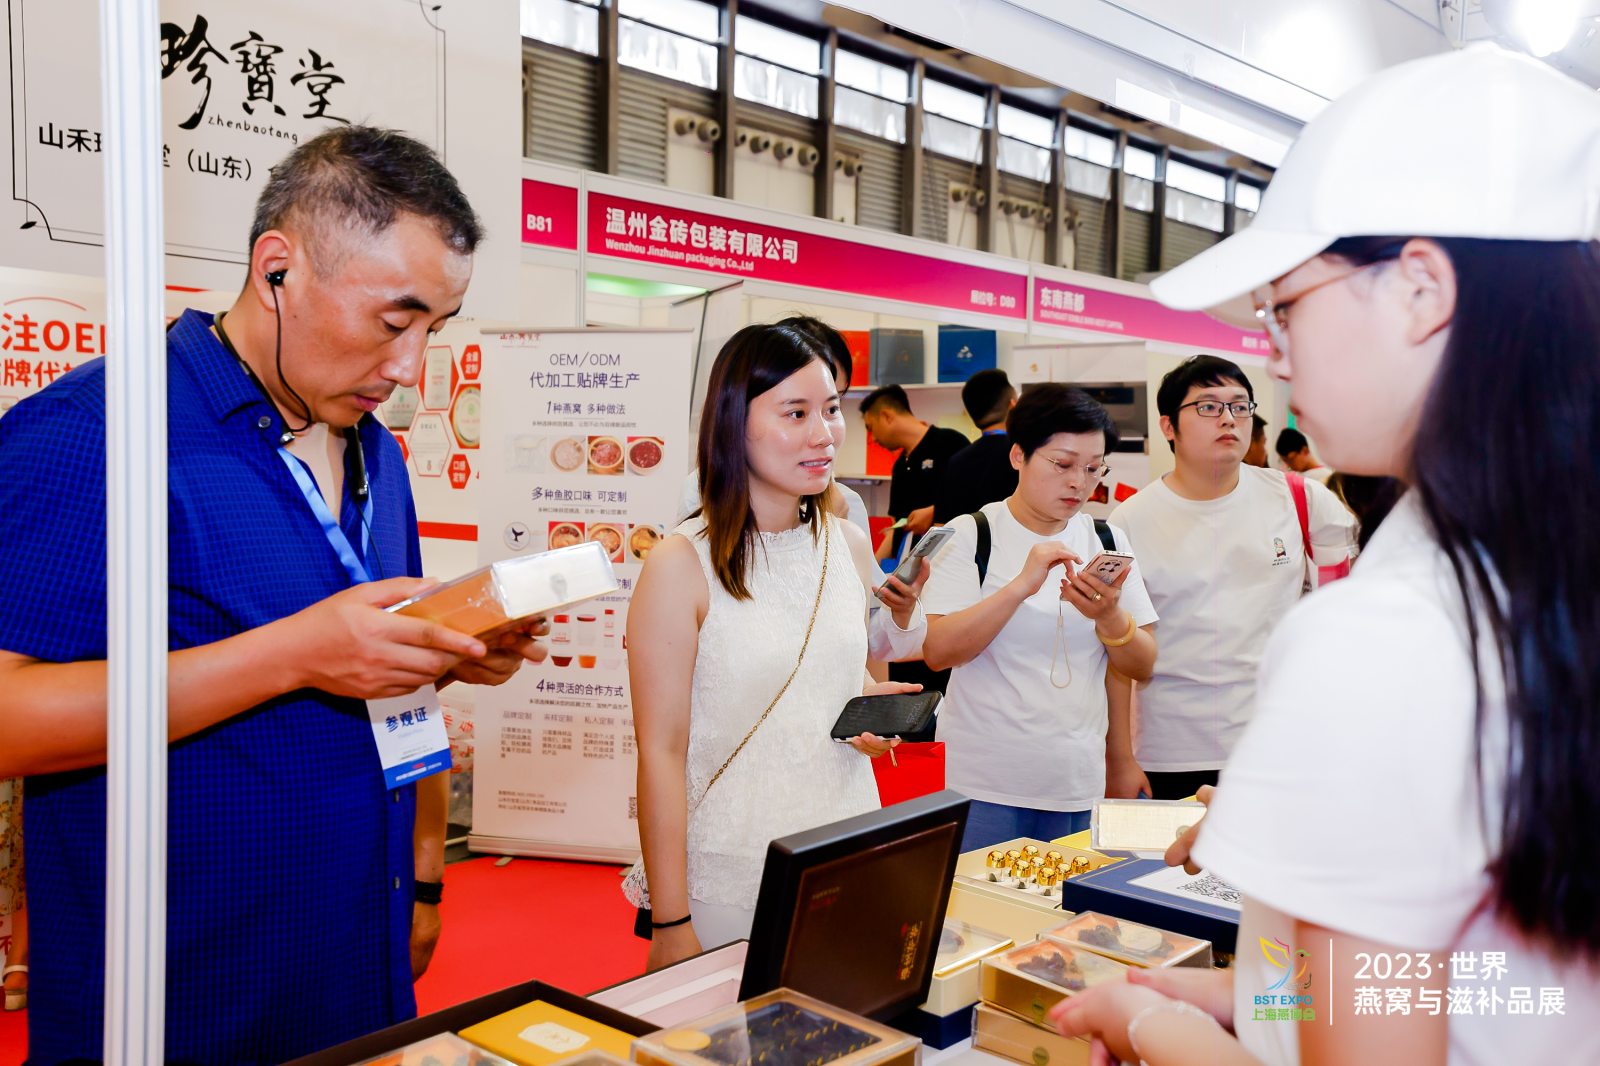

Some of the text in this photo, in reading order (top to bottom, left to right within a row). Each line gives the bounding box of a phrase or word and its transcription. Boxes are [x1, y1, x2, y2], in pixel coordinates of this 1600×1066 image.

[208, 115, 299, 144] zhenbaotang
[526, 213, 552, 233] B81
[605, 206, 799, 264] 温州金砖包装有限公司
[605, 238, 646, 255] Wenzhou
[647, 246, 685, 260] Jinzhuan
[685, 250, 726, 269] packaging
[550, 352, 621, 368] OEM/ODM
[530, 371, 640, 389] 代加工贴牌生产
[547, 401, 626, 415] 1种燕窝 多种做法
[531, 486, 627, 503] 多种鱼胶口味 可定制
[536, 679, 624, 697] 4种灵活的合作方式
[385, 706, 428, 733] 参观证
